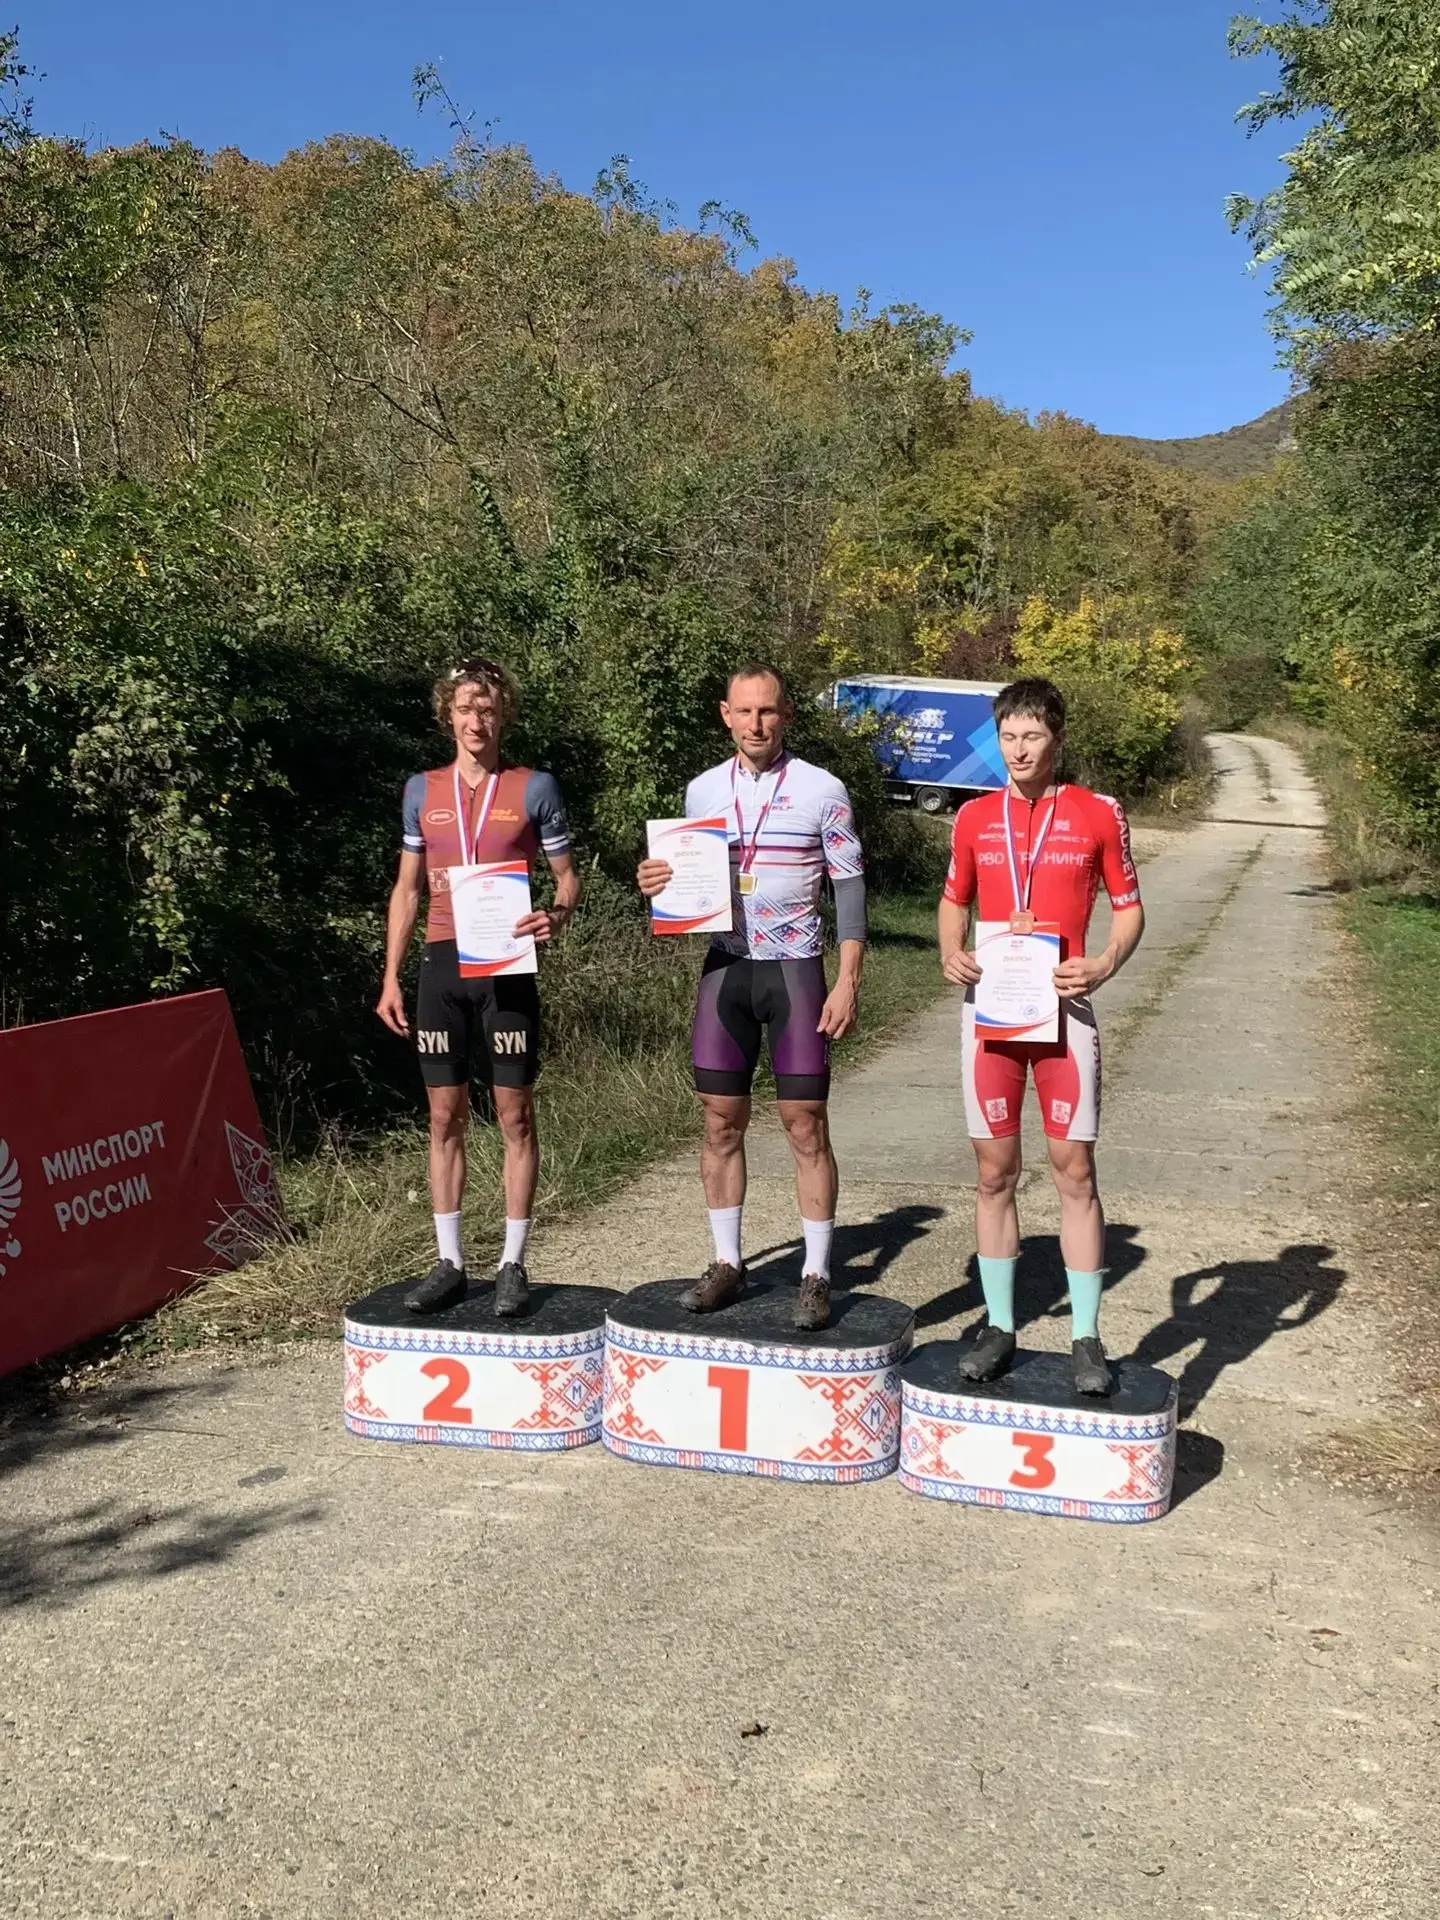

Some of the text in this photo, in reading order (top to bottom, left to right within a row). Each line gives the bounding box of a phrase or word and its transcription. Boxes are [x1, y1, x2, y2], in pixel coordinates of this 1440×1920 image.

[417, 1030, 449, 1054] SYN
[493, 1030, 527, 1054] SYN
[41, 1120, 166, 1185] МИНСПОРТ
[54, 1173, 152, 1232] РОССИИ
[420, 1358, 472, 1424] 2
[707, 1366, 749, 1452] 1
[1009, 1433, 1055, 1490] 3
